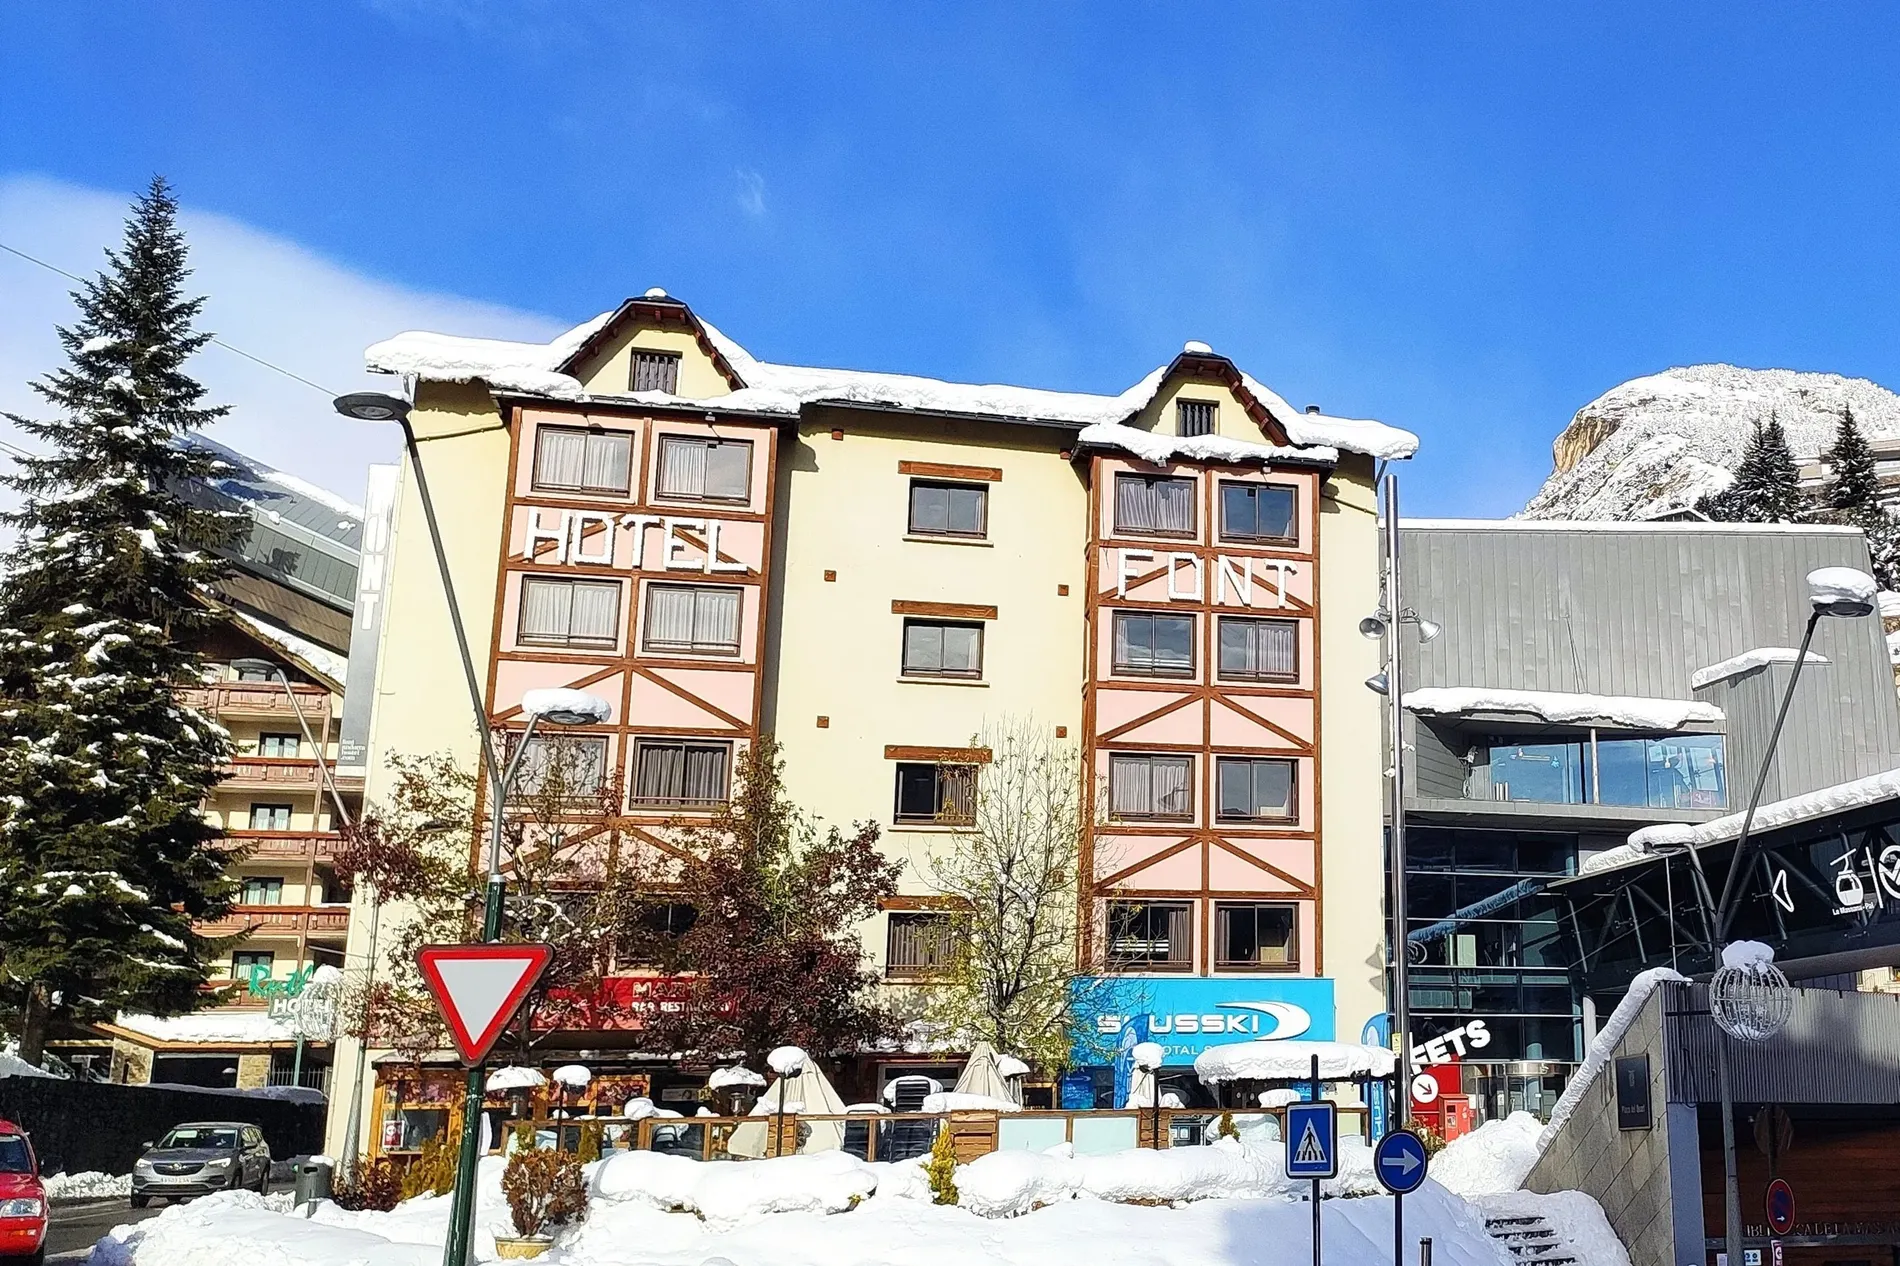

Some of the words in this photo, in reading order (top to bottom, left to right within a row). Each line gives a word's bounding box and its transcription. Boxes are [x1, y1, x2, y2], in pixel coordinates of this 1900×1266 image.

[523, 508, 749, 572] HOTEL
[1117, 548, 1298, 607] FONT
[1097, 1013, 1260, 1034] SUSSKI
[1161, 1045, 1200, 1056] OTAL
[1409, 1019, 1491, 1076] FETS
